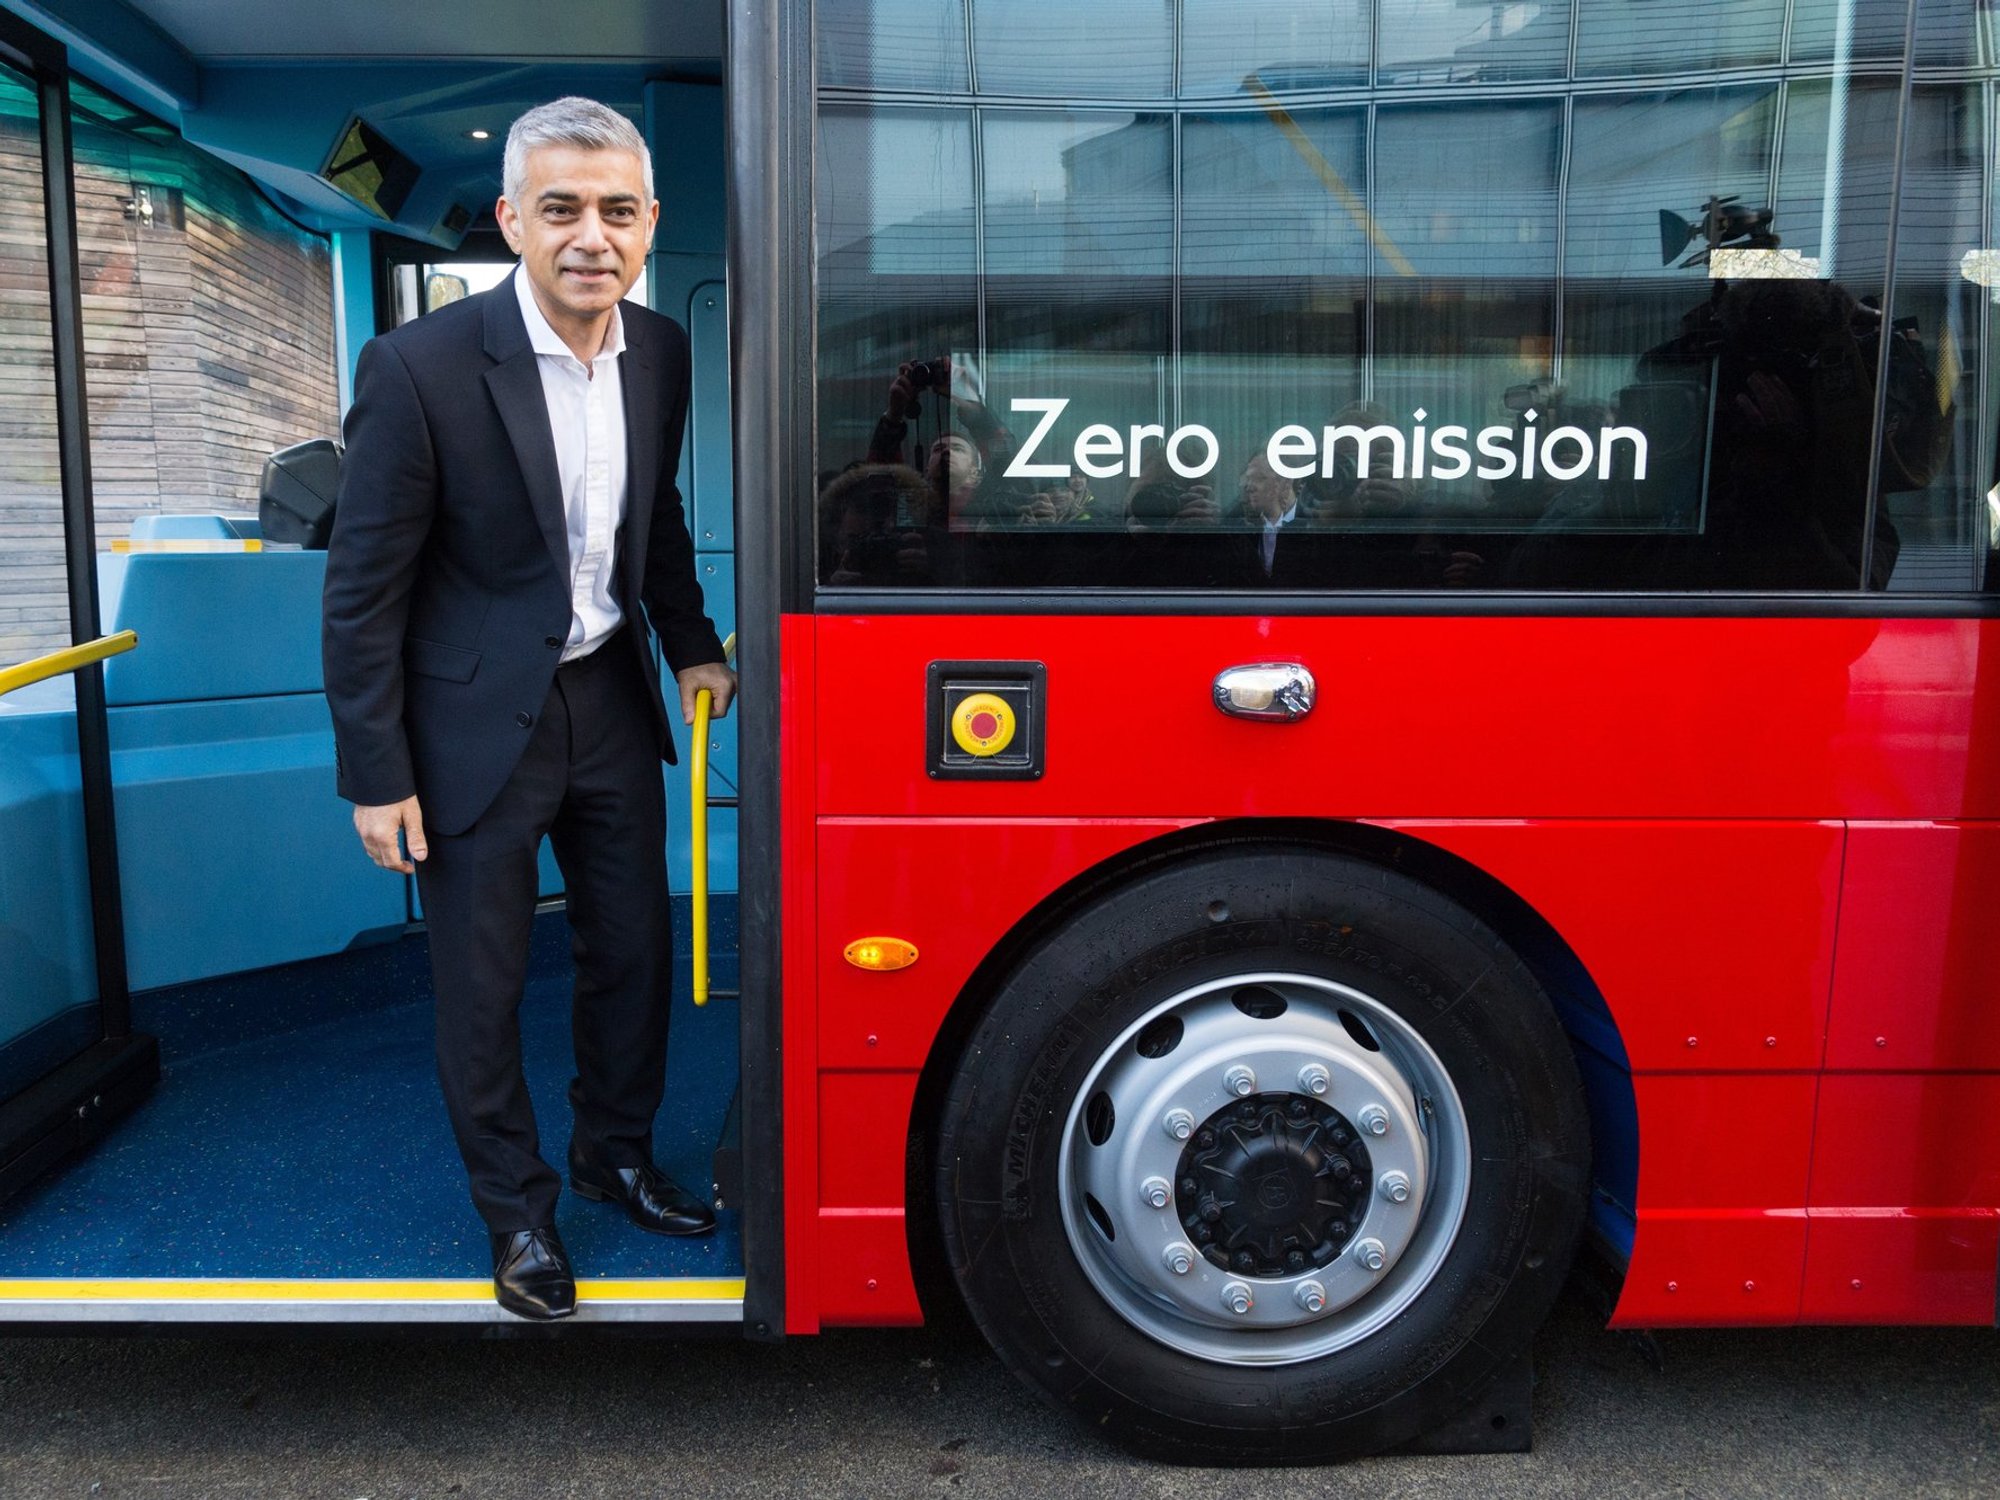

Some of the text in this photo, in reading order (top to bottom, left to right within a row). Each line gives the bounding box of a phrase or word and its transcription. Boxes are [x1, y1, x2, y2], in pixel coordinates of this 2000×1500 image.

[1002, 398, 1648, 480] Zero emission
[1007, 1030, 1070, 1178] MICHELIN
